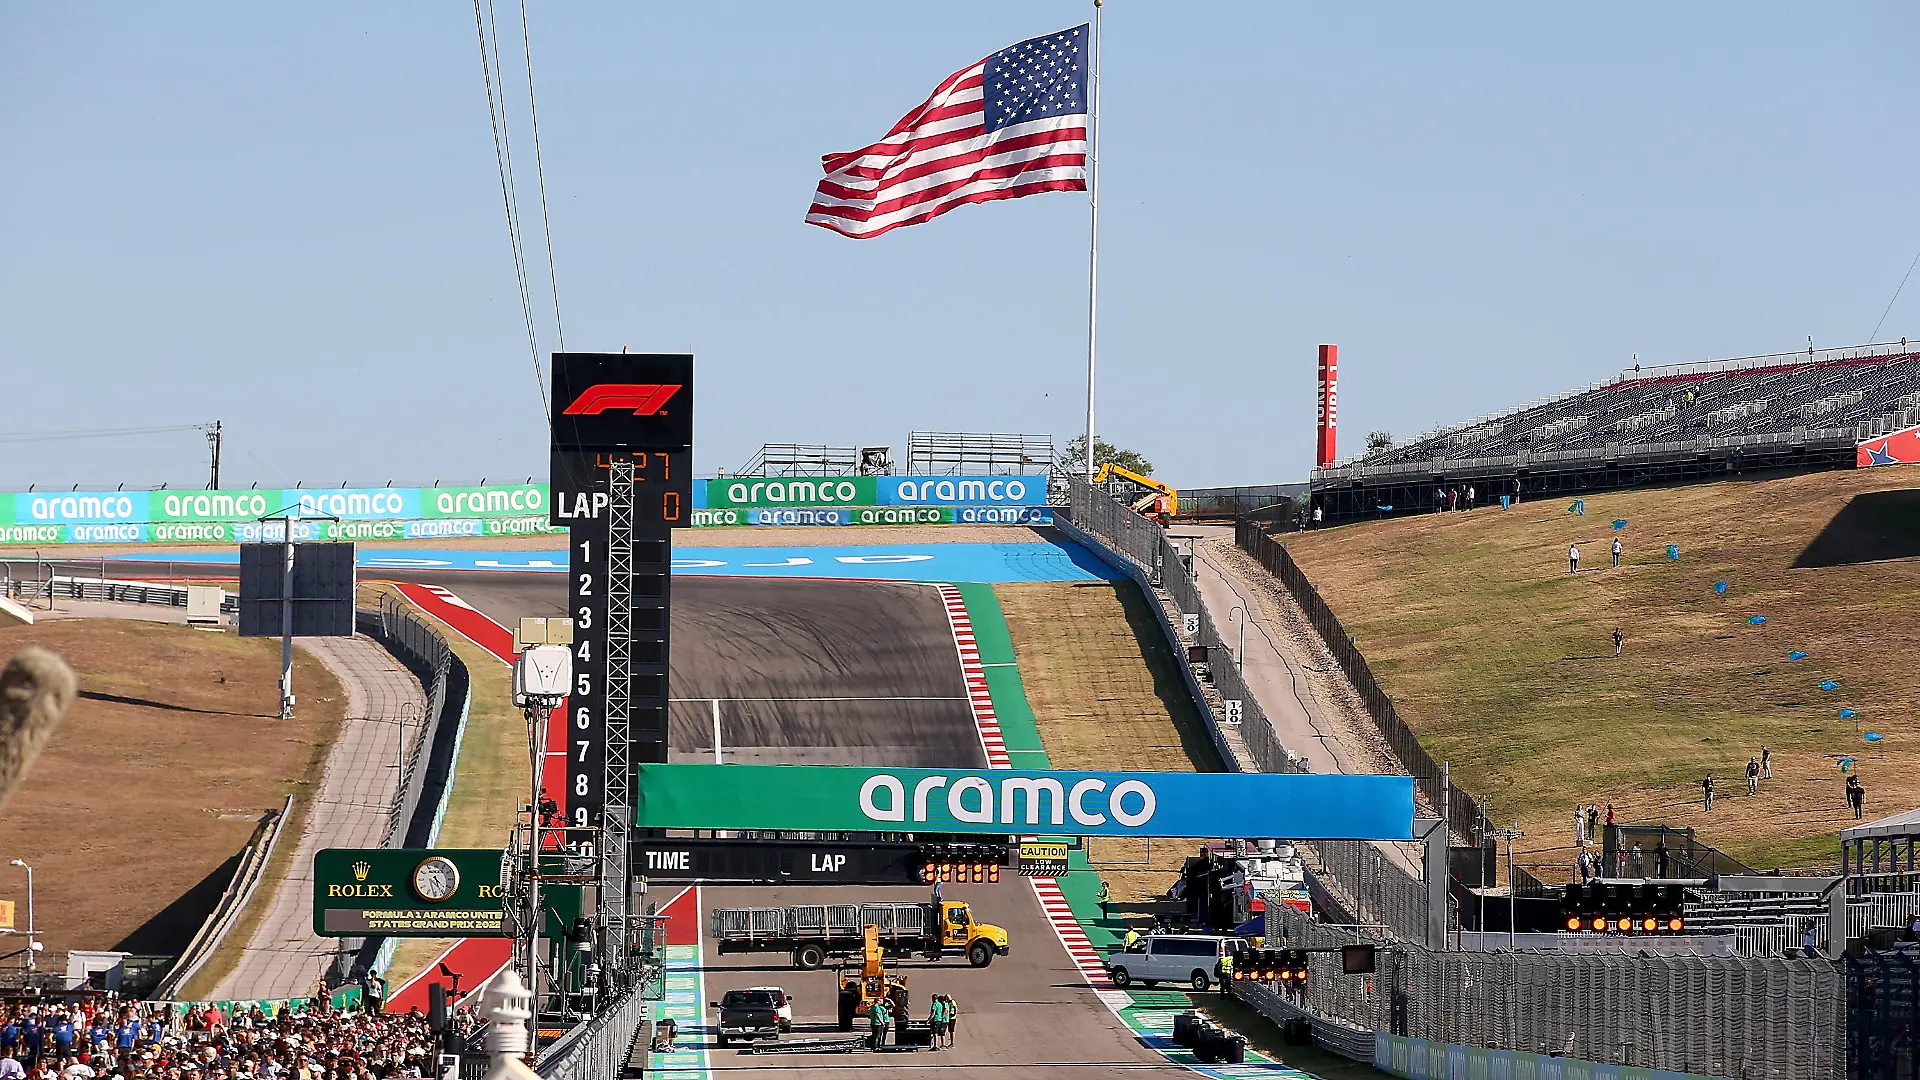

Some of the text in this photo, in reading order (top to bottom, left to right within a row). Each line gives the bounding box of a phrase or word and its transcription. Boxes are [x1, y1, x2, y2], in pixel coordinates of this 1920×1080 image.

[562, 384, 683, 416] F1
[727, 481, 857, 504] aramco
[898, 479, 1027, 501] aramco
[31, 496, 133, 520] aramco
[164, 494, 267, 517] aramco
[299, 492, 404, 515] aramco
[436, 489, 542, 514] aramco
[557, 492, 609, 519] LAP
[663, 491, 680, 521] 0
[691, 509, 738, 525] mco
[758, 508, 840, 524] aramco
[860, 507, 941, 524] aramco
[961, 507, 1043, 523] aramco
[74, 525, 140, 540] aramco
[155, 523, 225, 540] aramco
[327, 522, 395, 538] aramco
[411, 520, 475, 536] aramco
[579, 540, 590, 563] 1
[578, 573, 593, 596] 2
[578, 606, 592, 629] 3
[577, 640, 591, 662] 4
[577, 673, 591, 696] 5
[576, 707, 590, 730] 6
[576, 740, 590, 762] 7
[575, 774, 589, 796] 8
[858, 774, 1157, 826] aramco
[575, 807, 588, 828] 9
[645, 851, 846, 873] TIME LAP
[1020, 847, 1067, 856] CAUTION
[328, 884, 394, 897] ROLEX
[362, 910, 414, 919] FORMULA
[415, 911, 422, 919] 1
[422, 911, 470, 919] ARAMCO
[368, 920, 501, 929] STATES GRAND PRIX 2022
